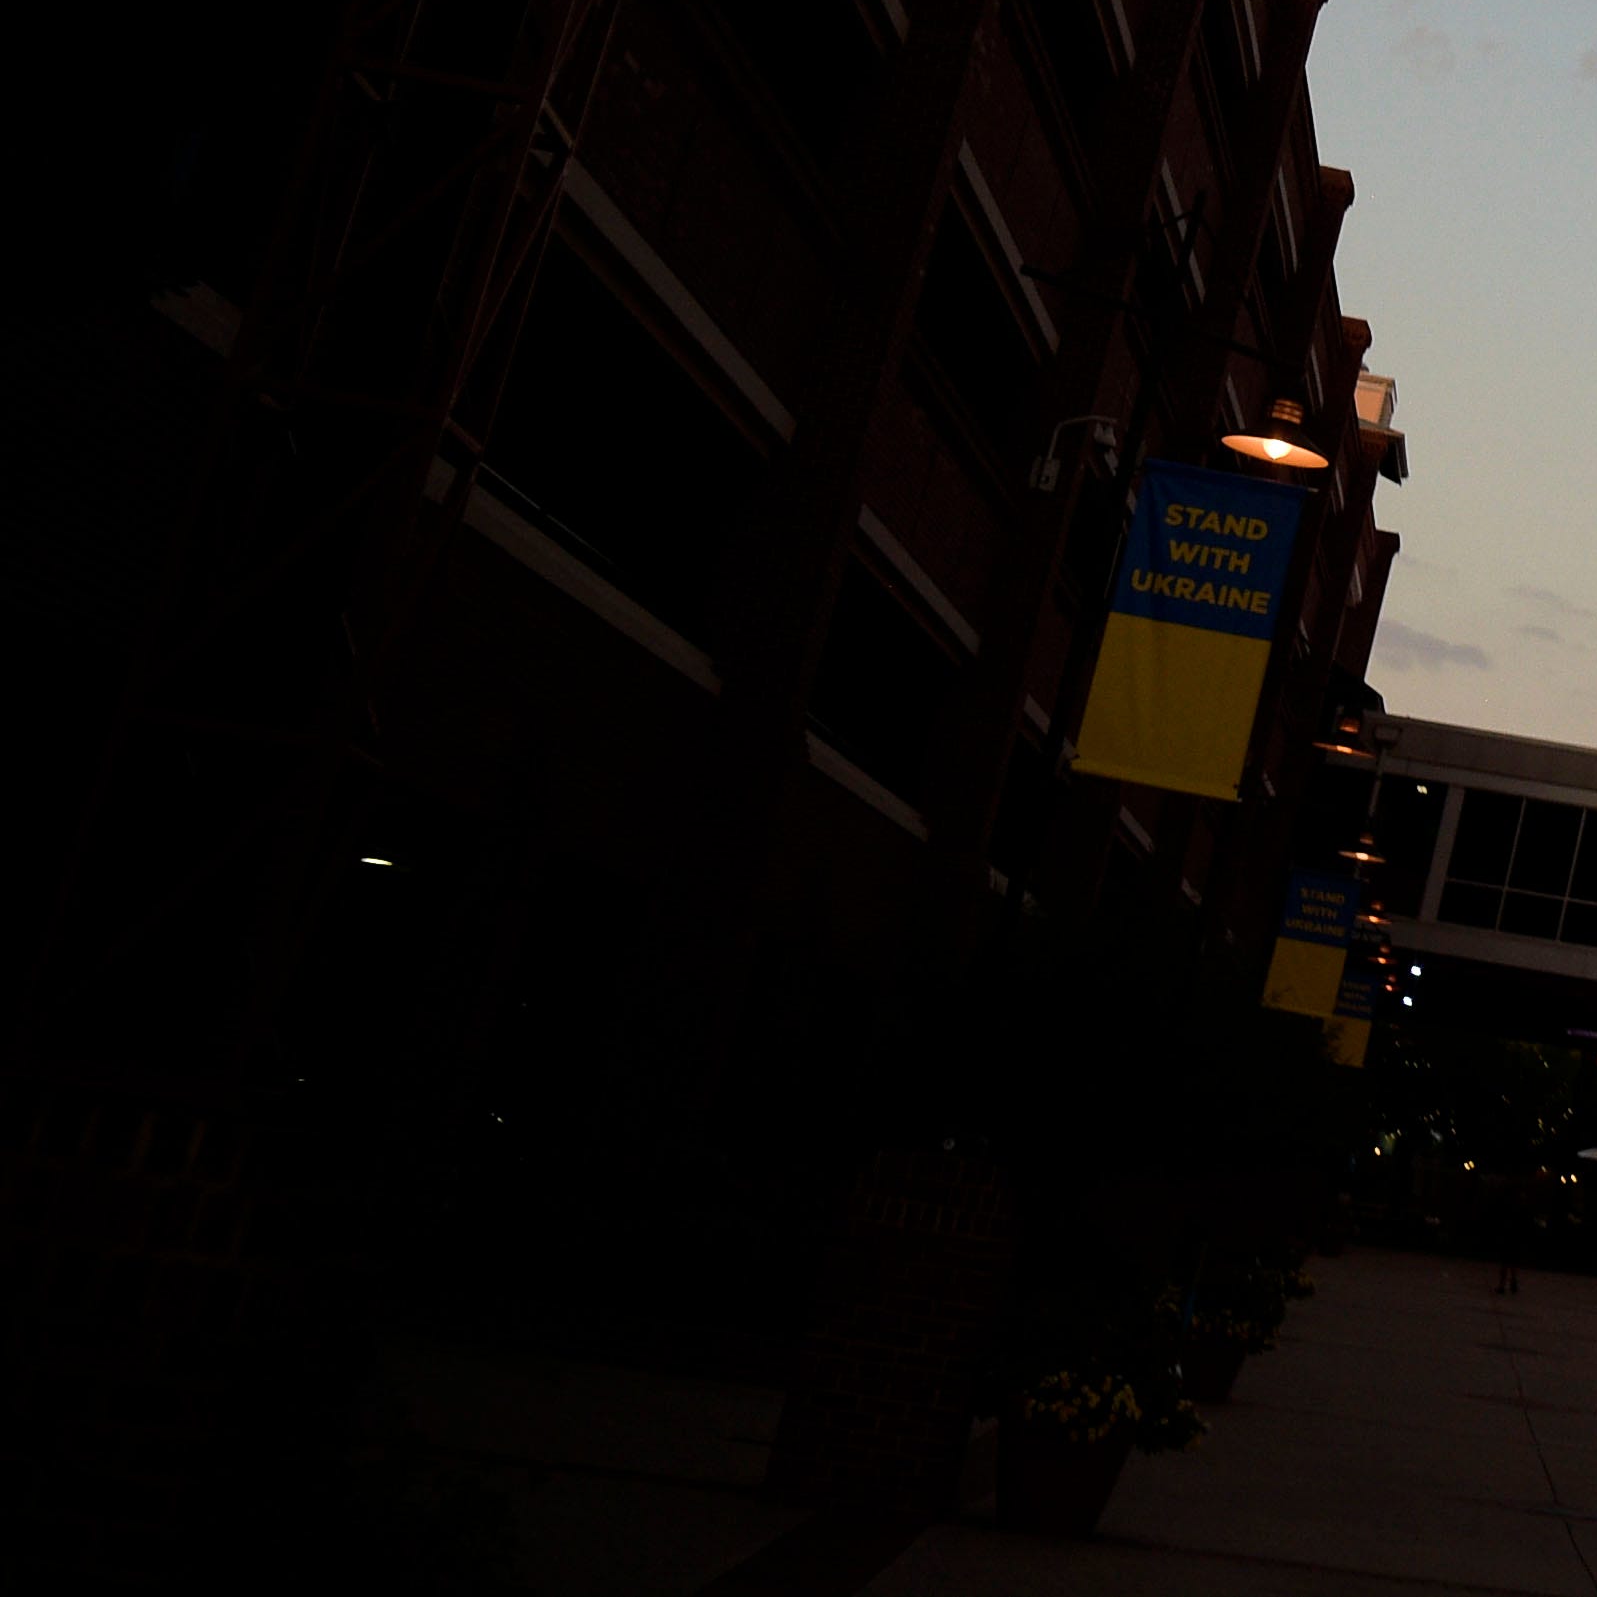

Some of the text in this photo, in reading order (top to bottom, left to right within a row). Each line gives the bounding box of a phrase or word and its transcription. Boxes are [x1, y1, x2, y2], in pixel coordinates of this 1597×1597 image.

[1165, 504, 1268, 540] STAND
[1169, 541, 1251, 574] WITH
[1132, 569, 1272, 615] UKRAINE
